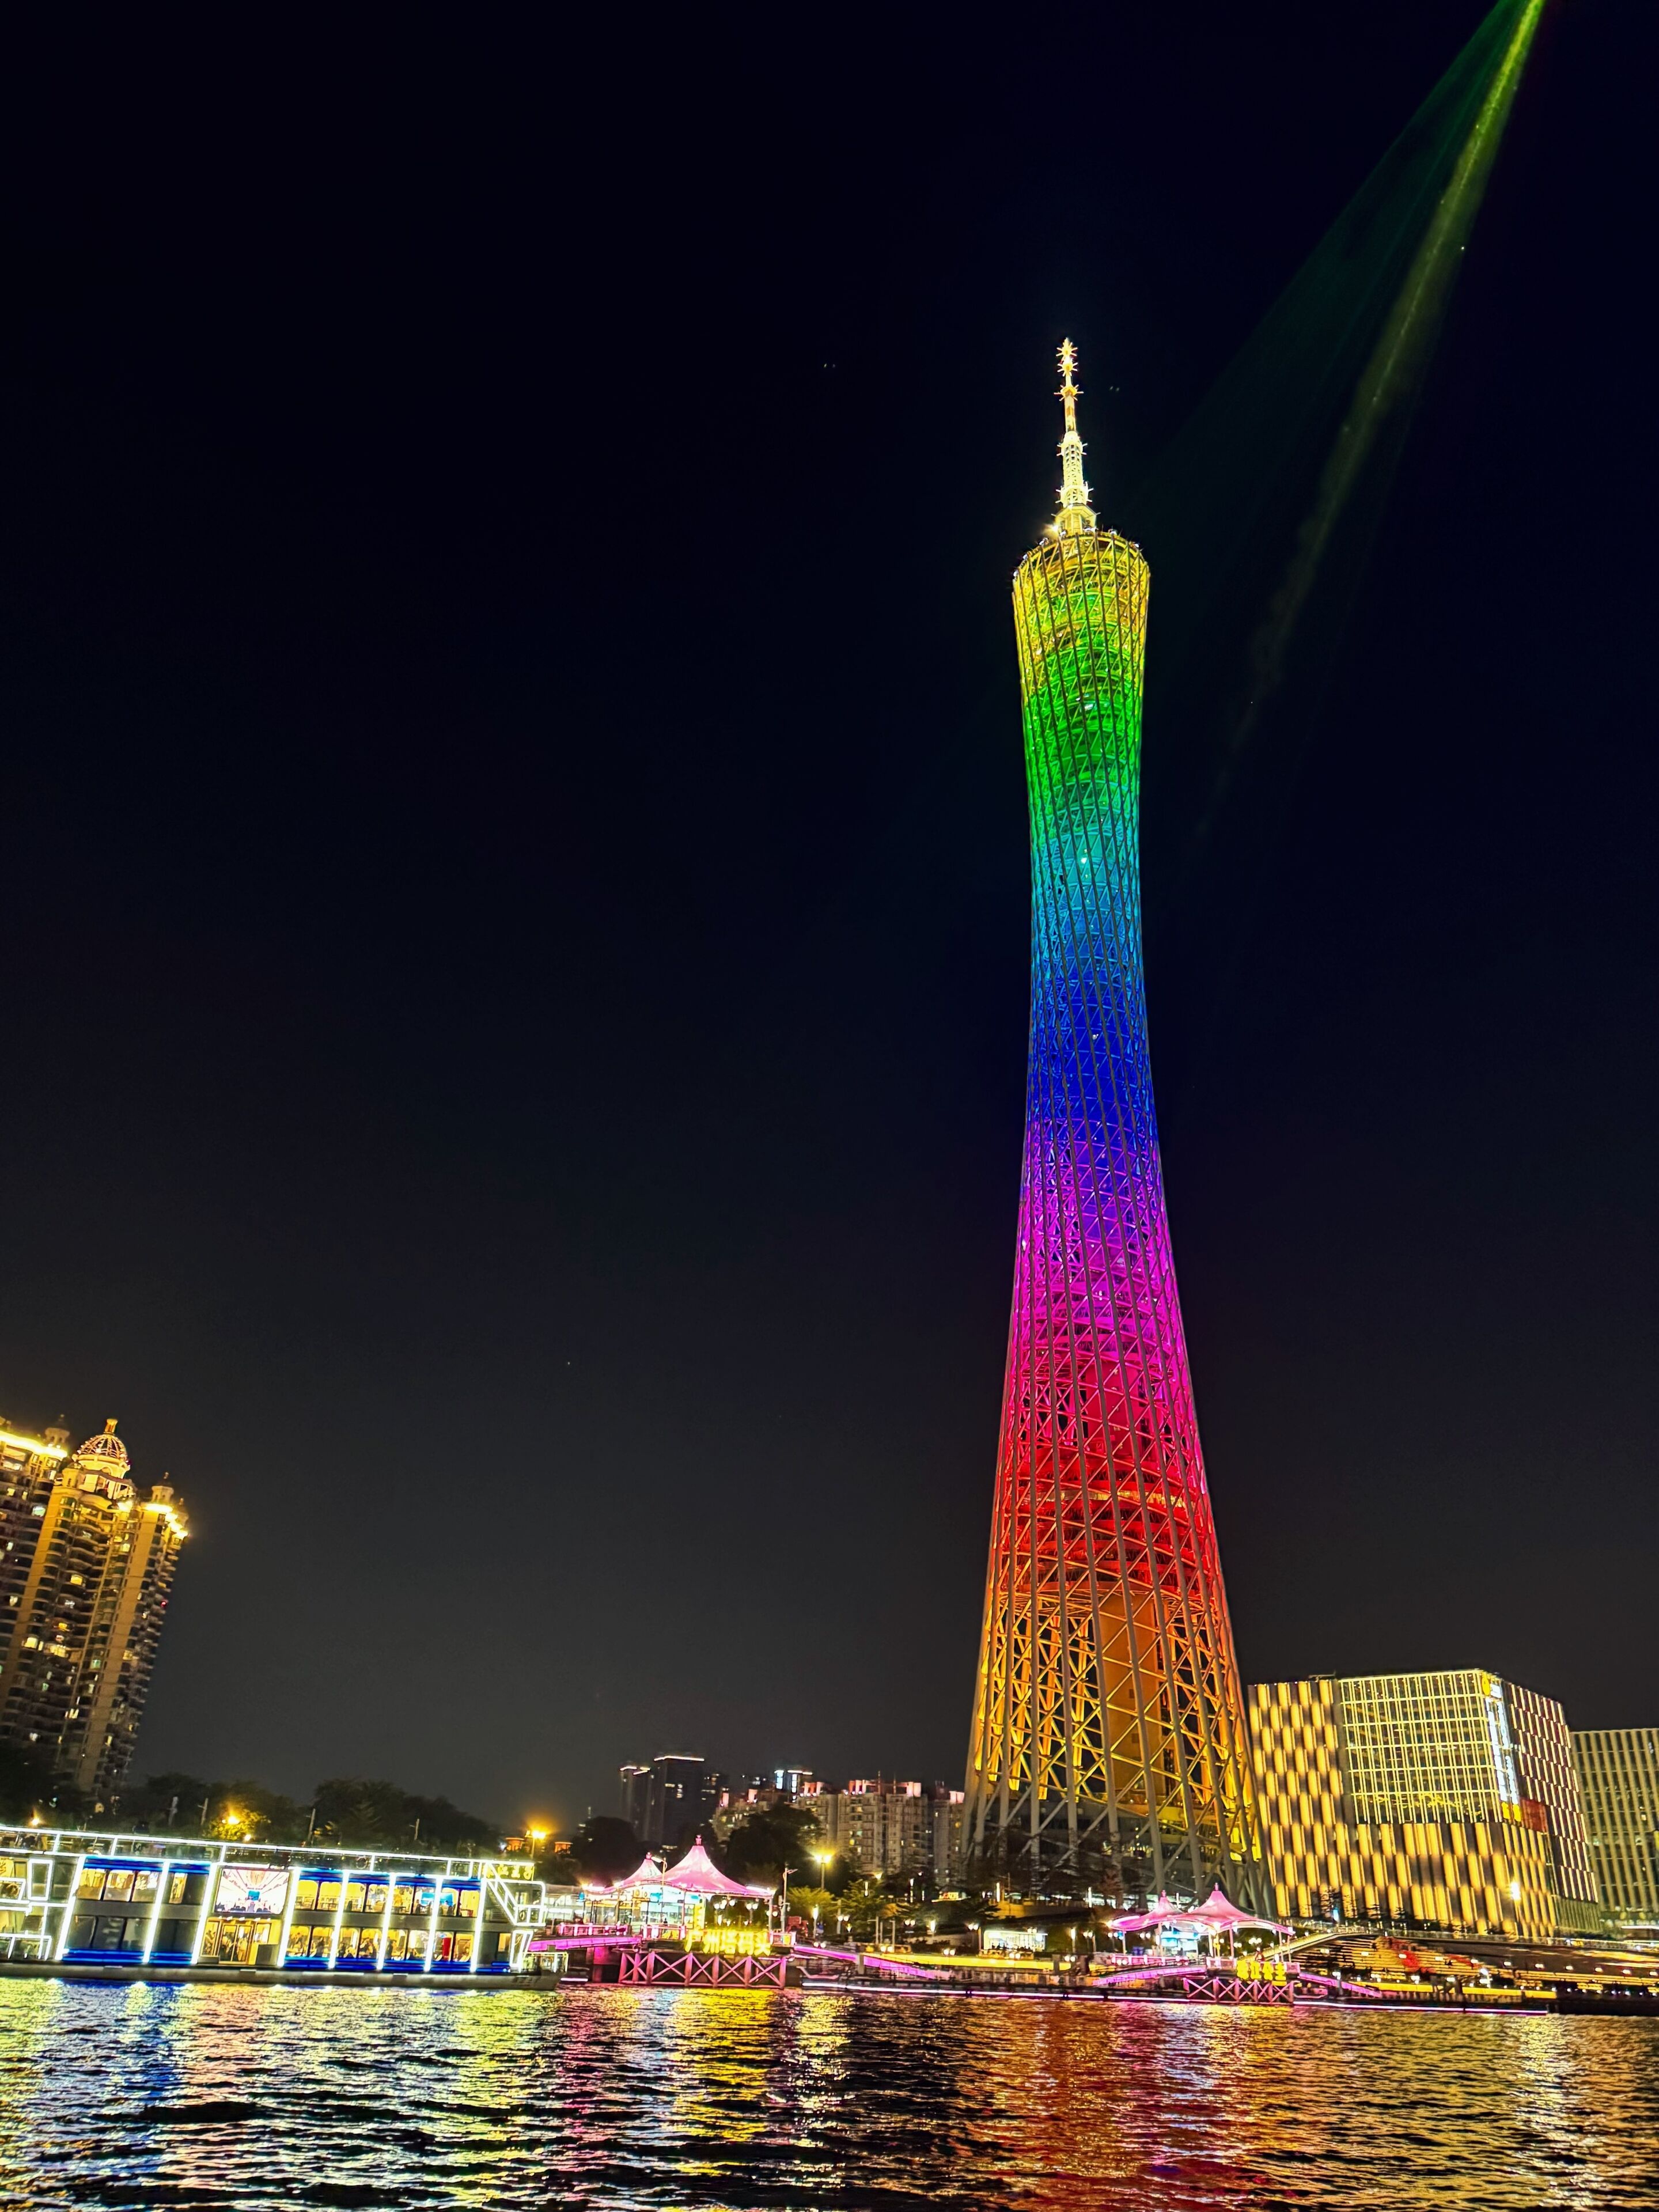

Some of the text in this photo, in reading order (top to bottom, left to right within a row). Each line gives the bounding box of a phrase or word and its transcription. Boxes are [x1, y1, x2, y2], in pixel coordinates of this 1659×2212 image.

[684, 1929, 771, 1956] 广州塔码头
